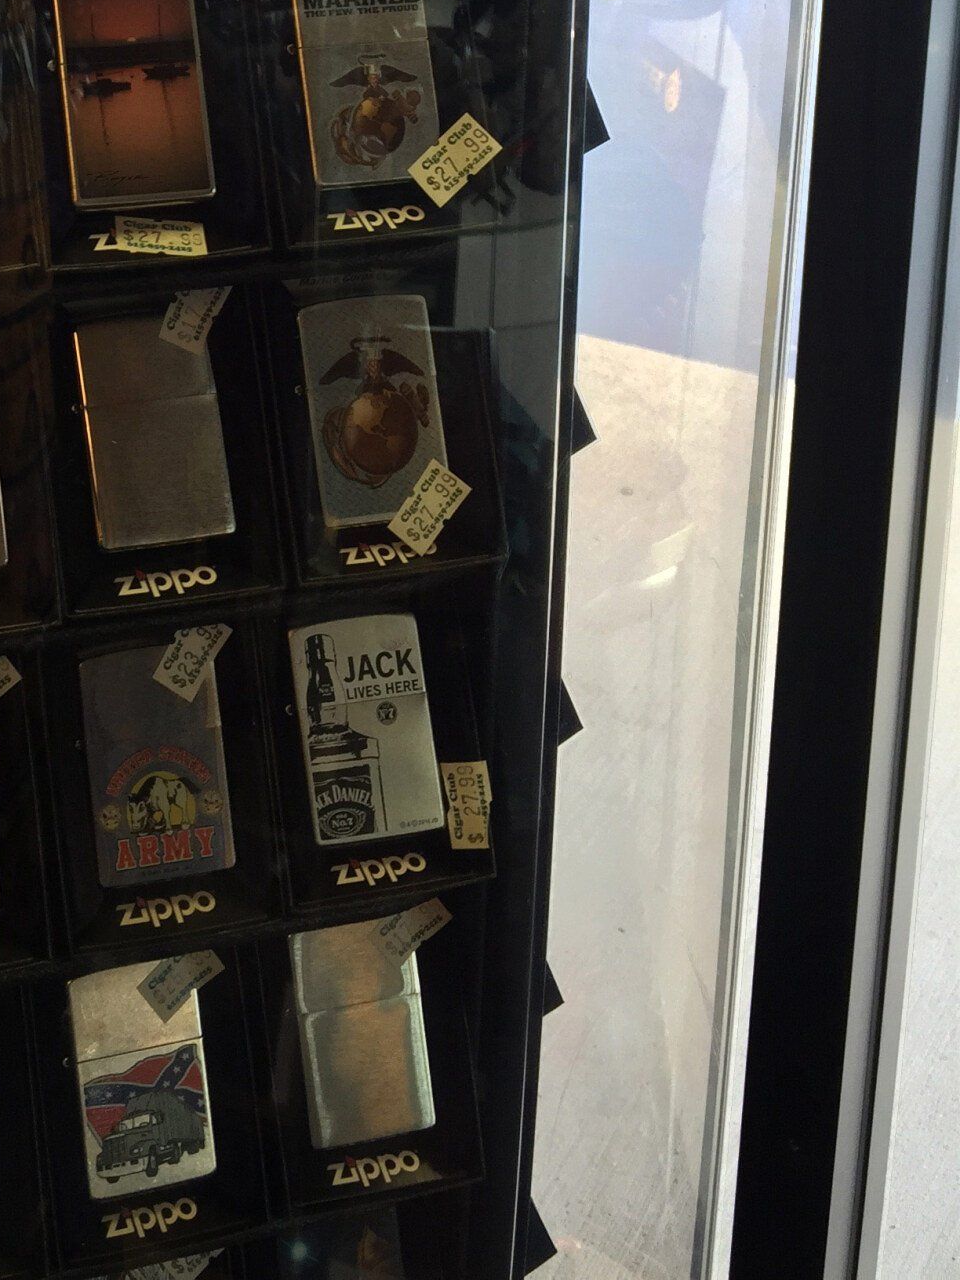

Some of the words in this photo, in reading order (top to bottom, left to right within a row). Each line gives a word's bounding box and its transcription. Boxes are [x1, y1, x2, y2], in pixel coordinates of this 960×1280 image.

[421, 145, 448, 170] Cigar
[447, 122, 472, 145] Club
[401, 494, 422, 523] Cigar
[421, 467, 440, 492] Club
[343, 648, 416, 683] JACK
[346, 685, 381, 700] LIVES
[116, 826, 215, 871] ARMY
